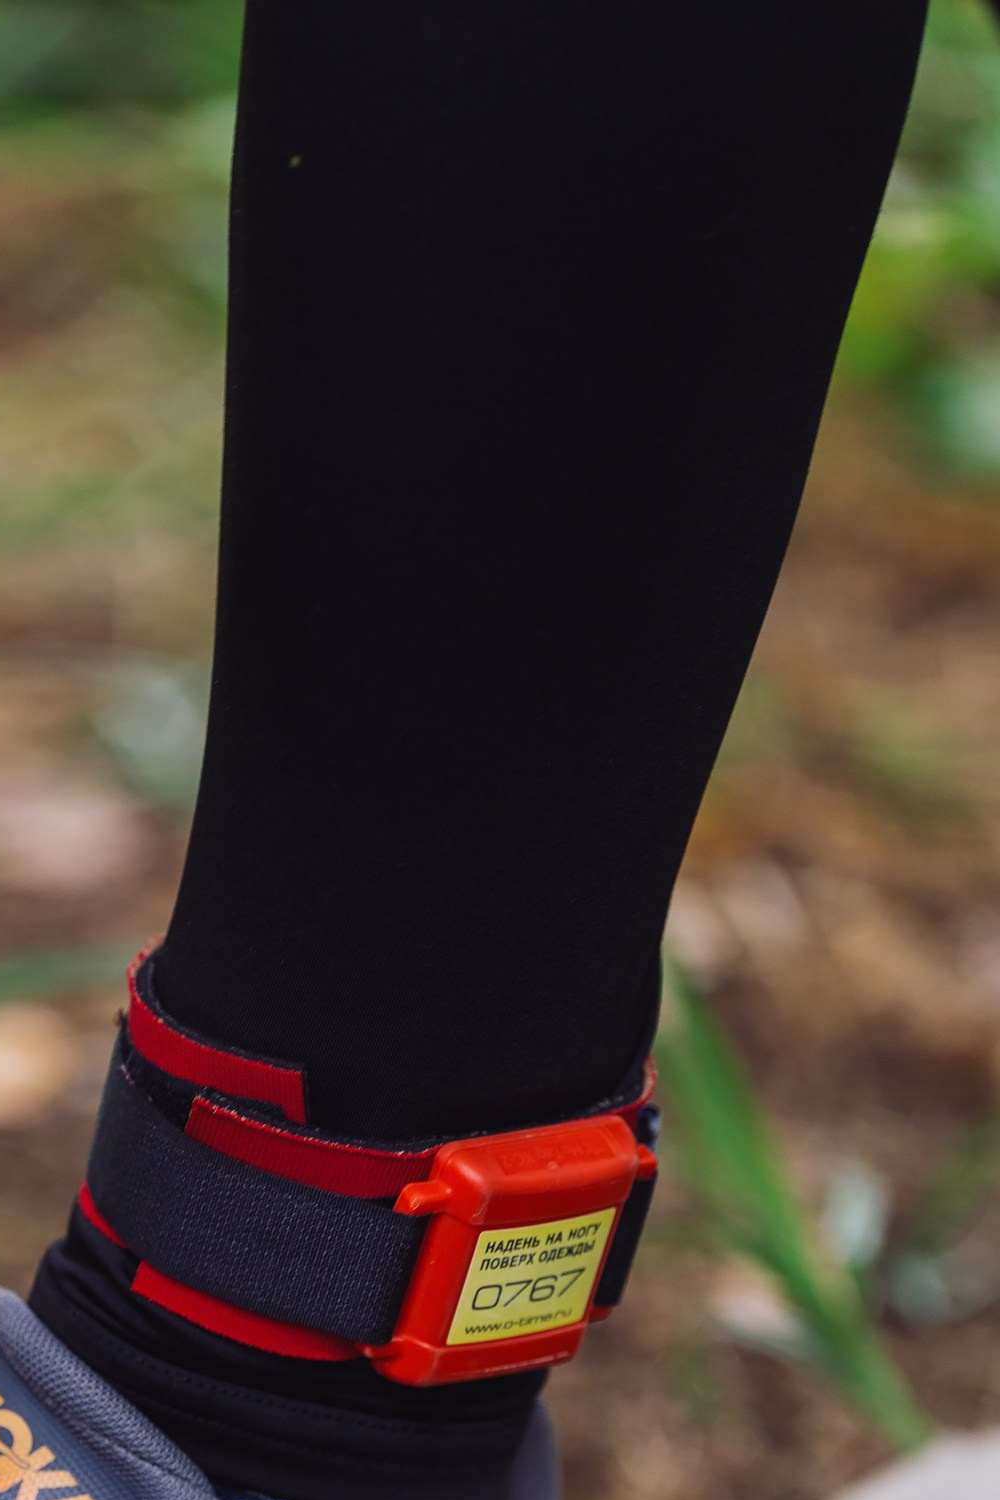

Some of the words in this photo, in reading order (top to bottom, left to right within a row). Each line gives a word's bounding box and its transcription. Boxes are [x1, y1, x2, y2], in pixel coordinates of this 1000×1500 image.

[485, 1235, 541, 1254] НАДЕНЬ
[545, 1232, 562, 1244] НА
[568, 1223, 602, 1241] НОГУ
[479, 1252, 535, 1271] ПОВЕРХ
[538, 1240, 596, 1263] ОДЕЖДЫ
[471, 1267, 586, 1310] 0767
[465, 1308, 572, 1335] www.o-time.ru
